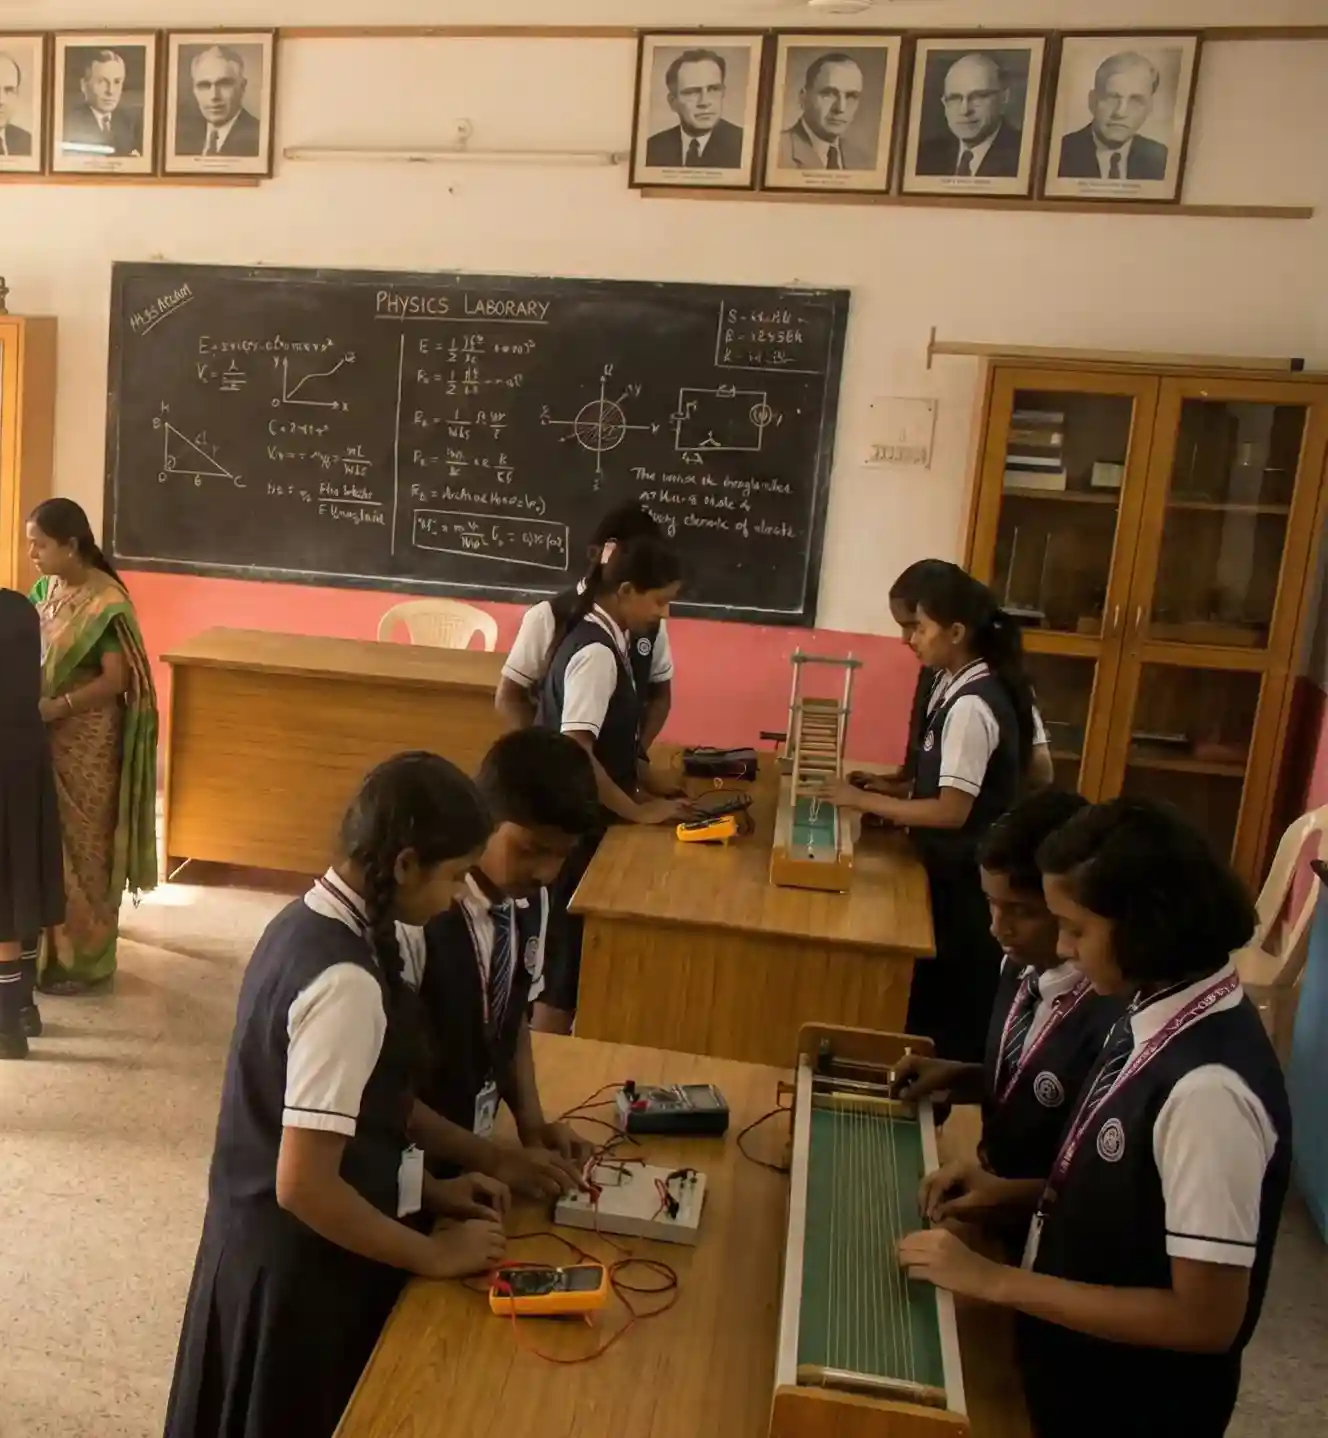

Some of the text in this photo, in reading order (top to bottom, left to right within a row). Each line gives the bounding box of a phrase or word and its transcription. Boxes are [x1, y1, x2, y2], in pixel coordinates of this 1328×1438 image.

[376, 290, 550, 322] PHYSICS LABORARY
[630, 467, 656, 481] The
